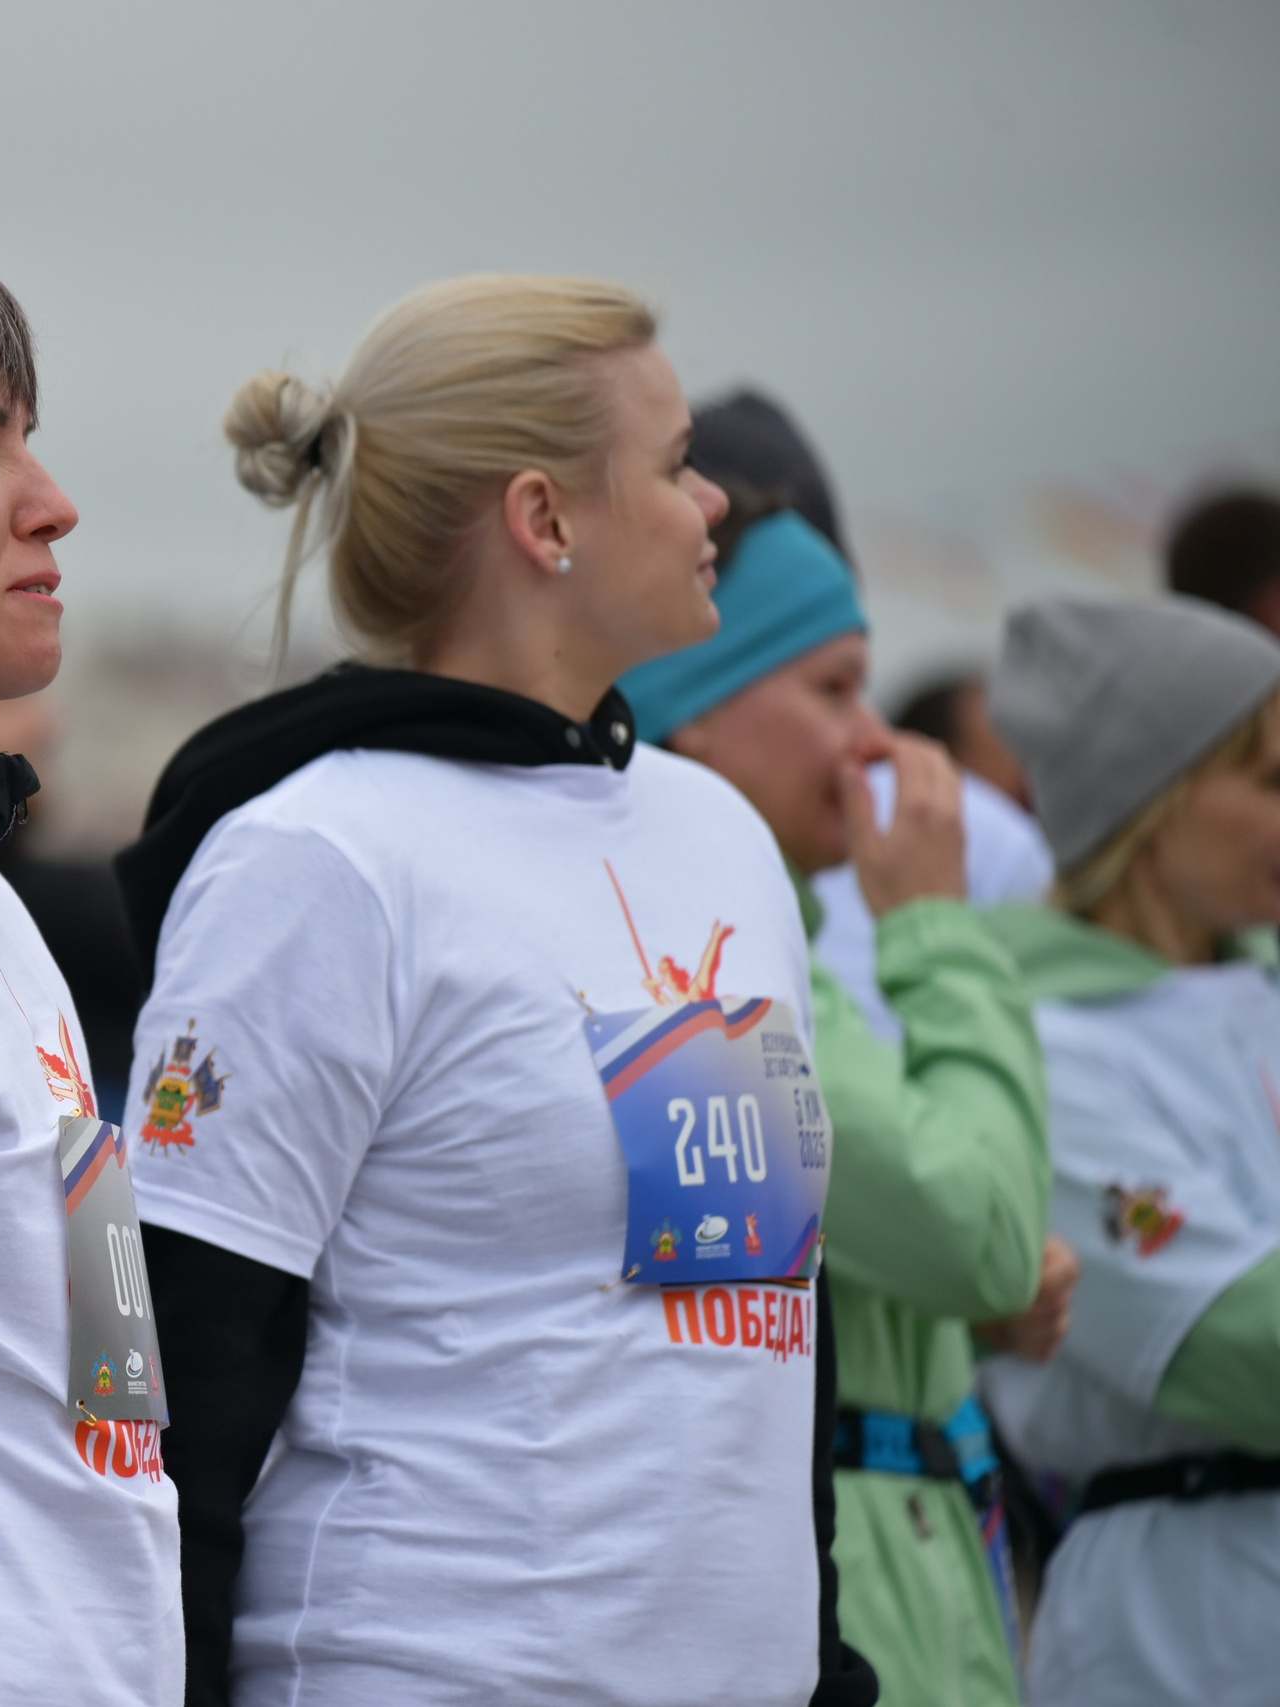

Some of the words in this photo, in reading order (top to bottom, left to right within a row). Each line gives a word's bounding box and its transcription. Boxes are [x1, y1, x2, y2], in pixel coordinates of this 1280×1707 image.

[667, 1093, 768, 1187] 240
[798, 1129, 826, 1170] 2025
[661, 1287, 813, 1363] ПОБЕДА!
